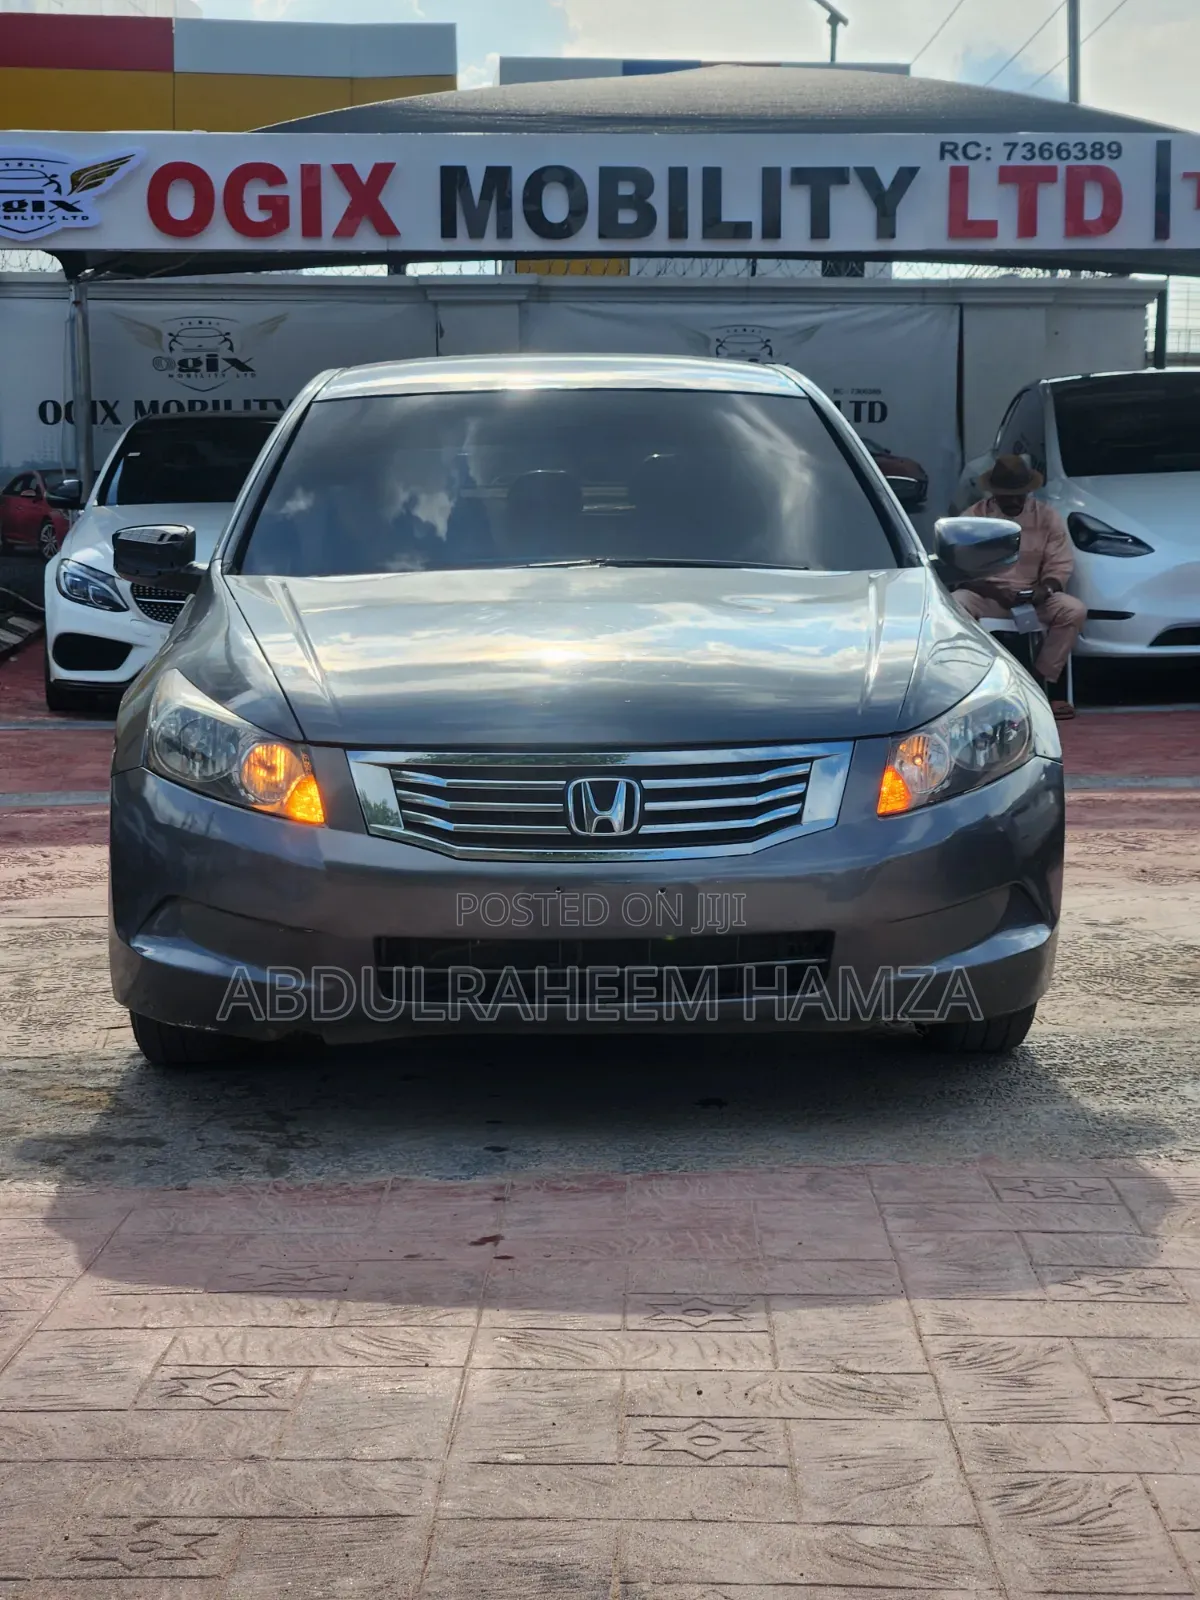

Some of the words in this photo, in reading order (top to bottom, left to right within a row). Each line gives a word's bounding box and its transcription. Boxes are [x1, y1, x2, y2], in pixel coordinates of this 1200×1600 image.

[939, 141, 991, 162] RC:
[1003, 141, 1123, 161] 7366389
[0, 199, 84, 213] gix
[147, 161, 401, 238] OGIX
[439, 165, 921, 239] MOBILITY
[947, 164, 1123, 239] LTD
